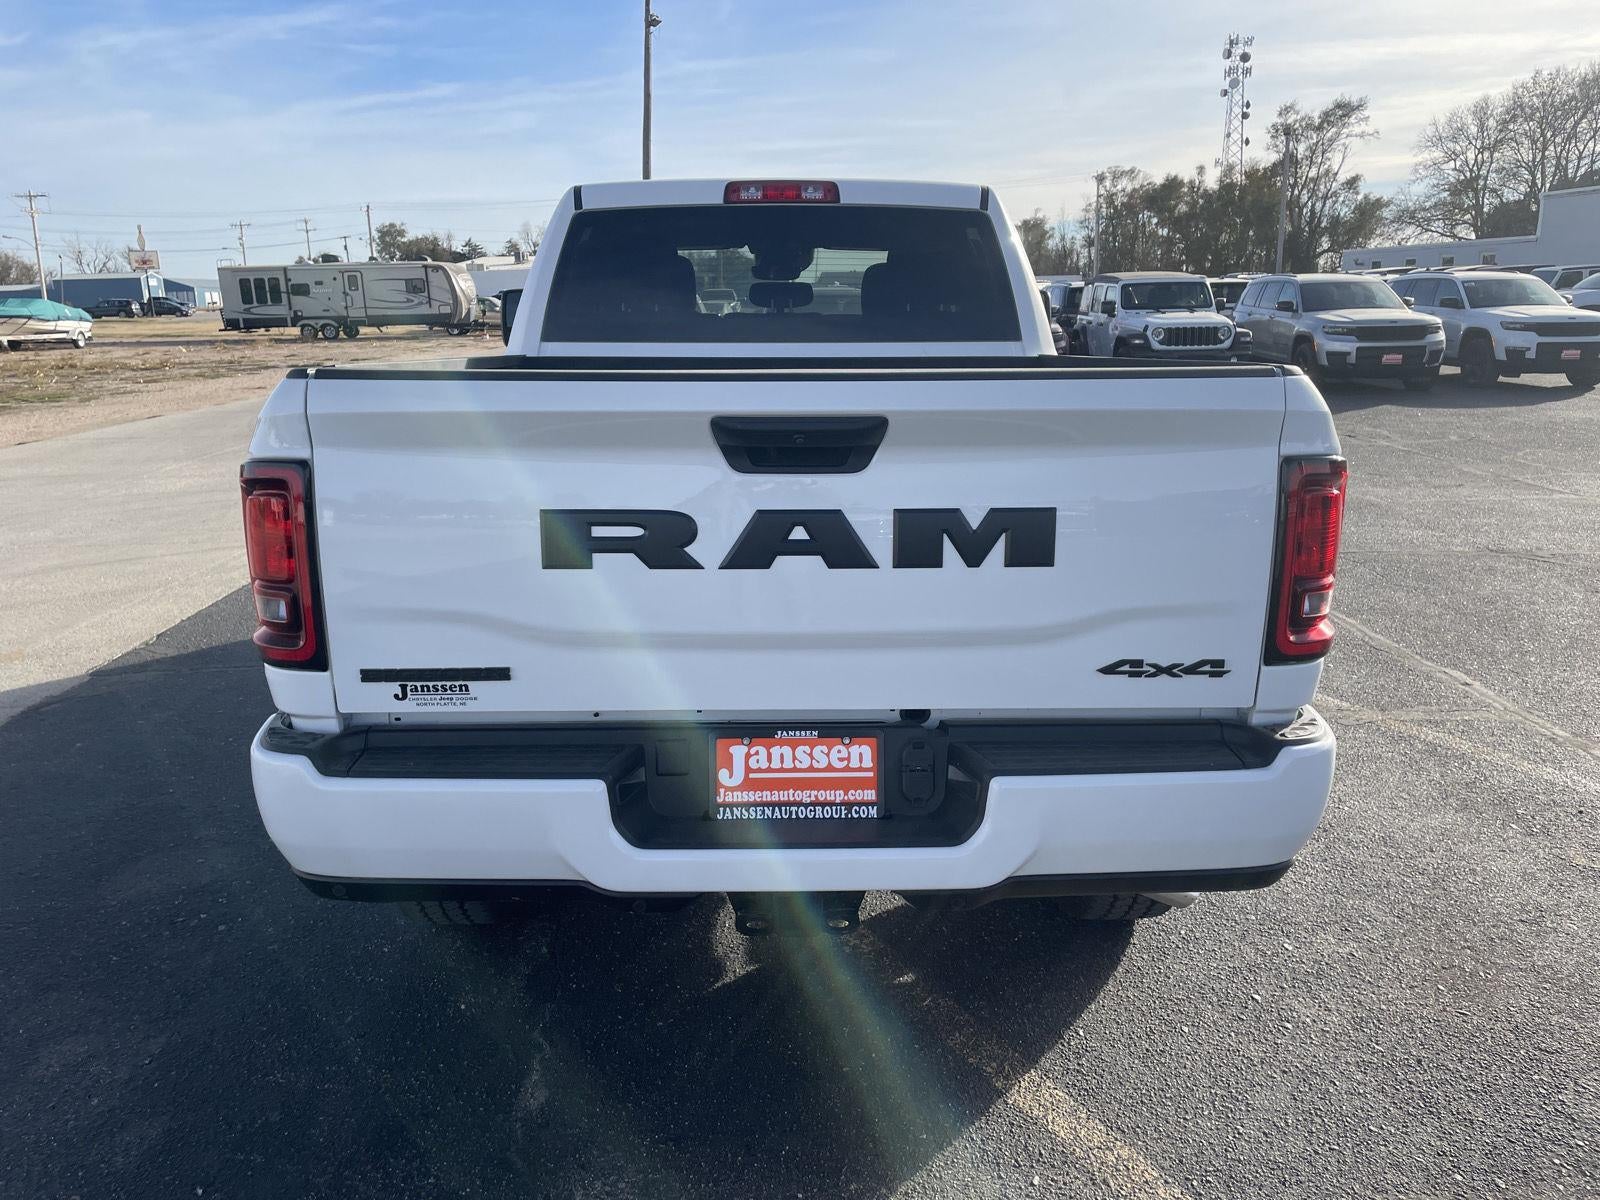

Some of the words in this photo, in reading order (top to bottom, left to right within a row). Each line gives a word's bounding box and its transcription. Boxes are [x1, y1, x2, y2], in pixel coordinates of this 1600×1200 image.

[540, 507, 1057, 570] RAM
[1095, 658, 1232, 678] 4x4
[393, 683, 470, 702] Janssen
[774, 730, 819, 739] JANSSEN
[718, 743, 874, 787] Janssen
[716, 787, 876, 804] Janssenautogroup.com
